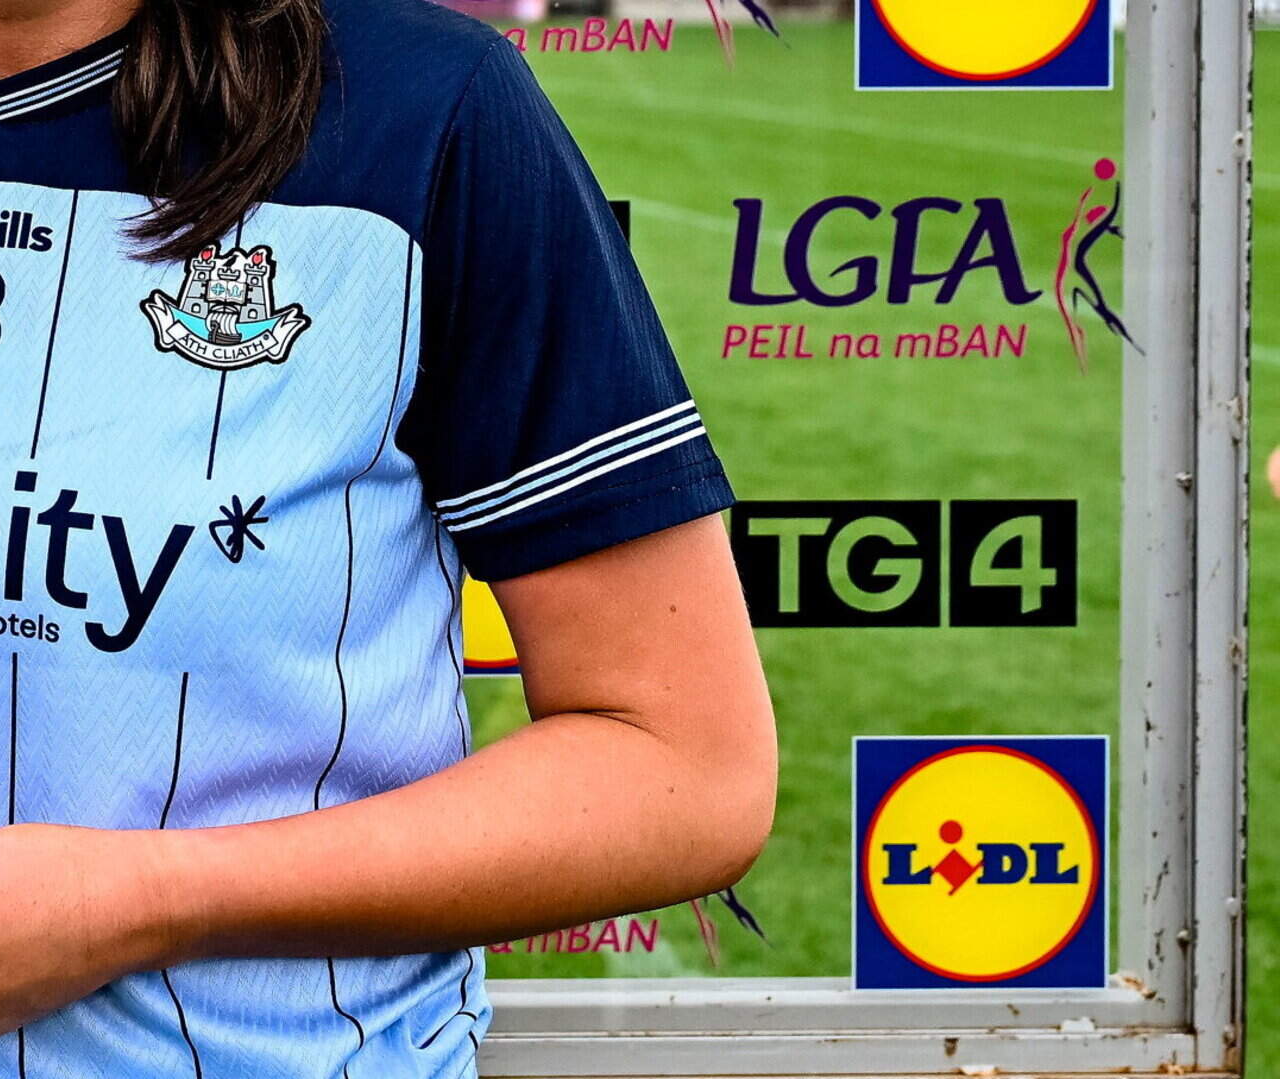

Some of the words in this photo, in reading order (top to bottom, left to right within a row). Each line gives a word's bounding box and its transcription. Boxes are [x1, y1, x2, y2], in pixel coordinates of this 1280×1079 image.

[541, 17, 673, 52] mBAN
[728, 195, 1043, 307] LGFA
[722, 325, 813, 359] PEIL
[829, 332, 881, 359] na
[895, 324, 1027, 359] mBAN
